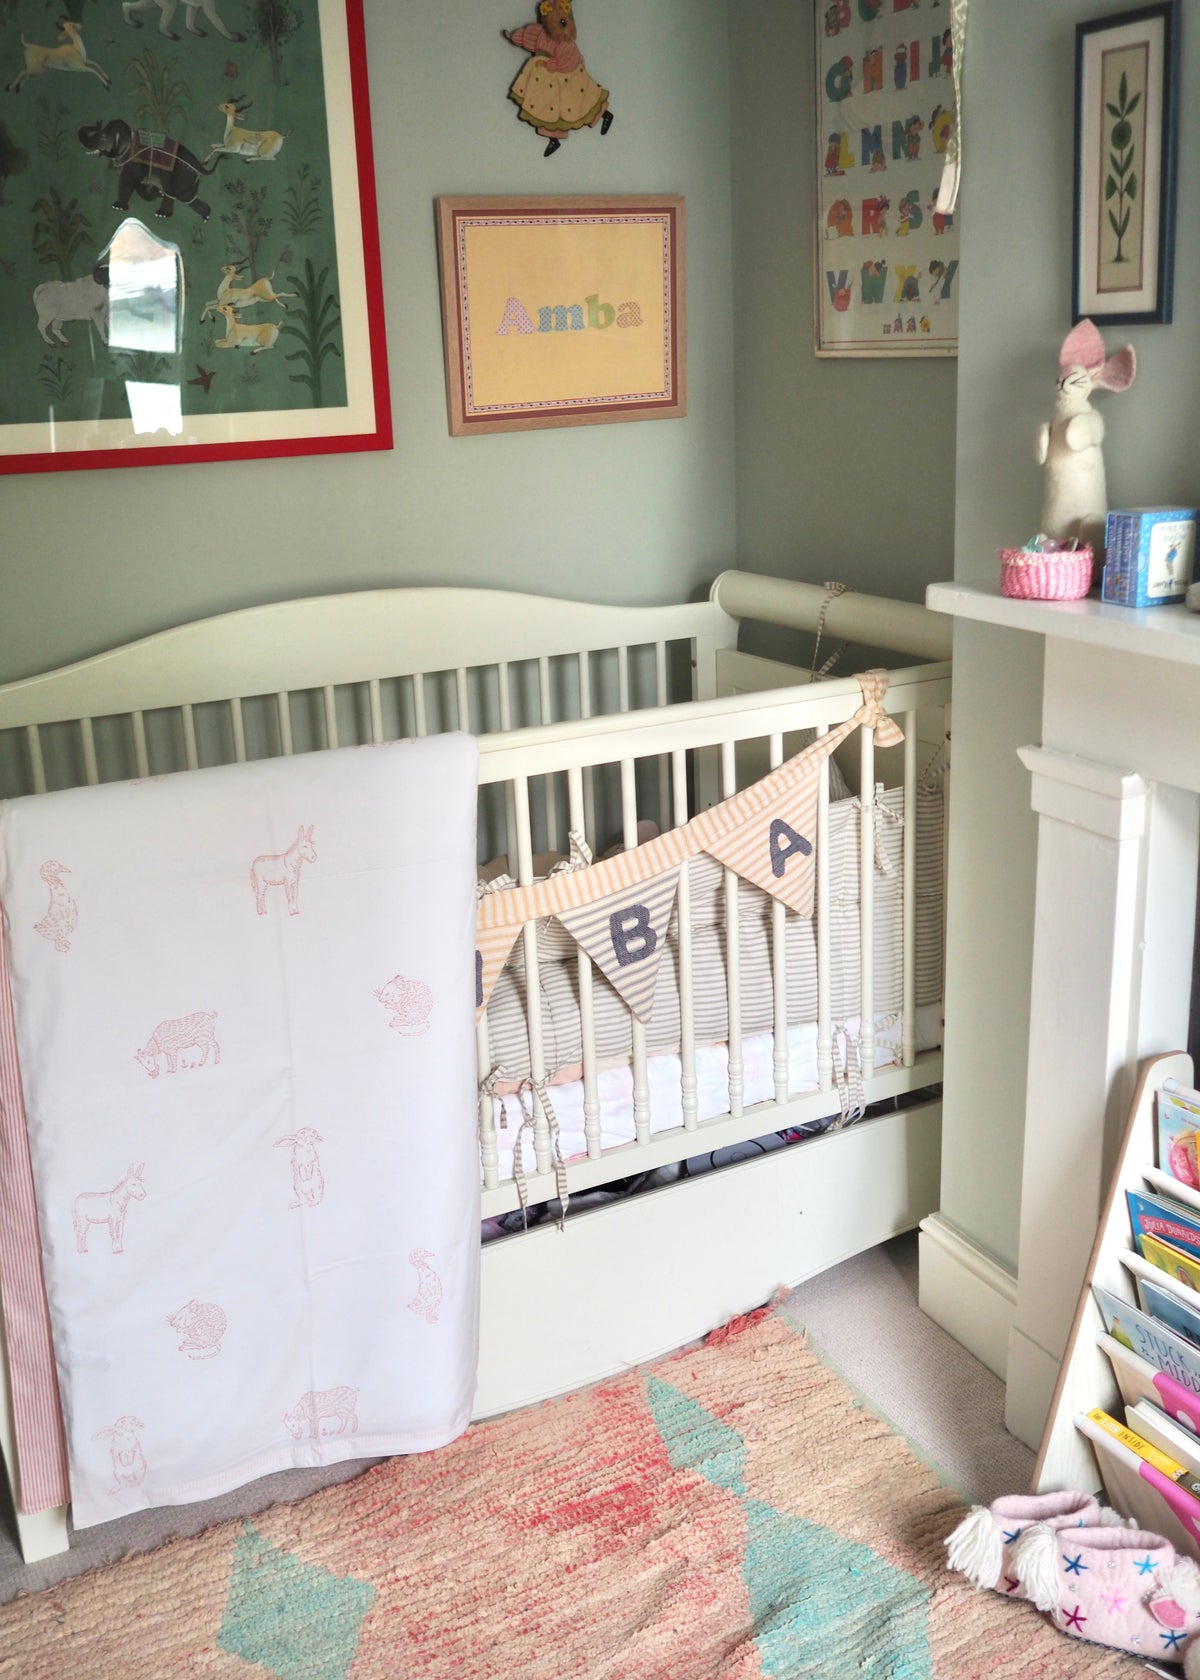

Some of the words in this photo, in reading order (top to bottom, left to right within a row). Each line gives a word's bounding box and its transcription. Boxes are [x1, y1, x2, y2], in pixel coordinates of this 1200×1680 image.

[862, 125, 884, 166] M
[495, 293, 644, 336] Amba
[609, 903, 657, 967] B
[769, 818, 813, 878] A
[1144, 1218, 1165, 1232] JULIA
[1135, 1324, 1190, 1372] STUCK
[1118, 1431, 1145, 1450] INSIDE
